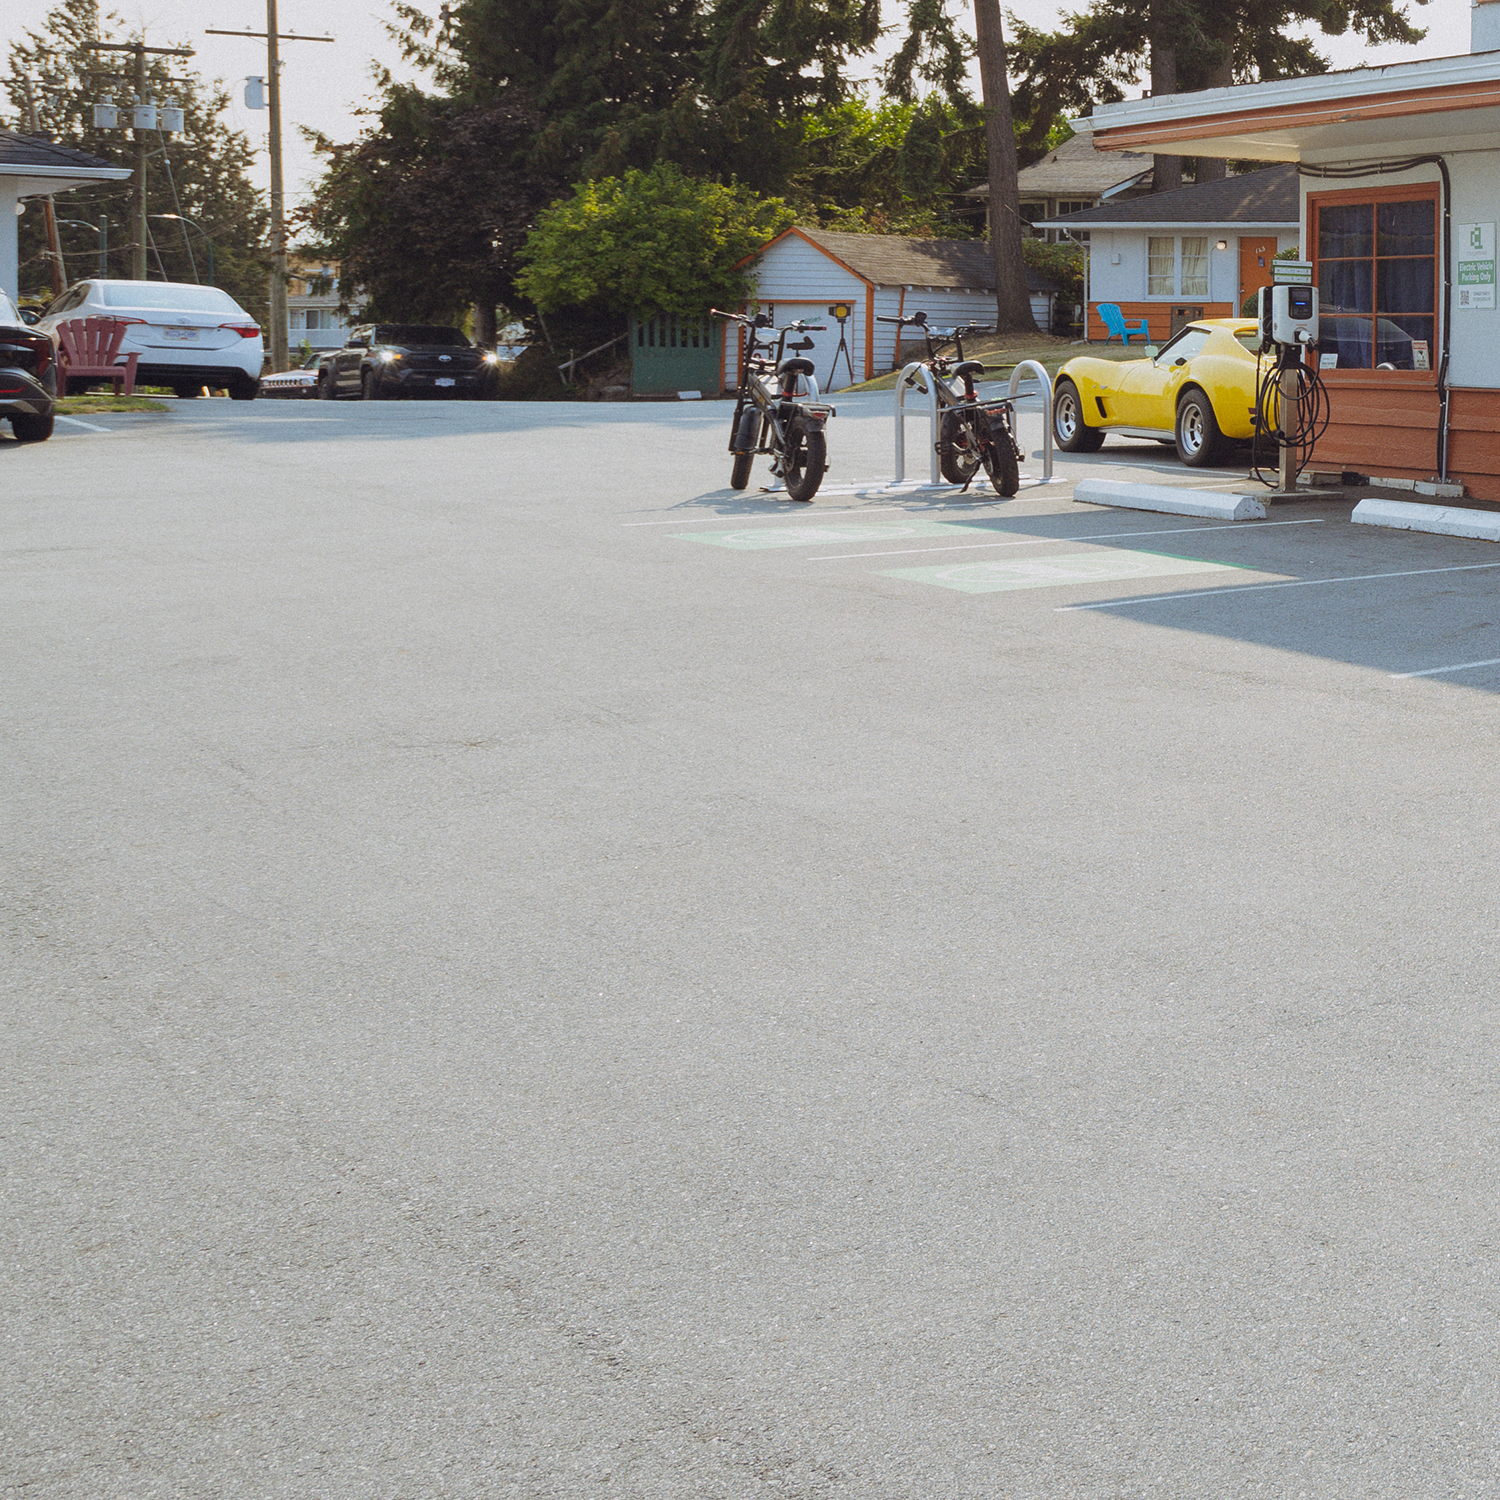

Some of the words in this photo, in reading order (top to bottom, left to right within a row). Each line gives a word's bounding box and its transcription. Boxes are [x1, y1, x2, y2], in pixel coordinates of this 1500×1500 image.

[1460, 263, 1476, 272] Electric
[1477, 261, 1493, 271] Vehicle
[1461, 272, 1480, 283] Parking
[1479, 271, 1491, 283] Only
